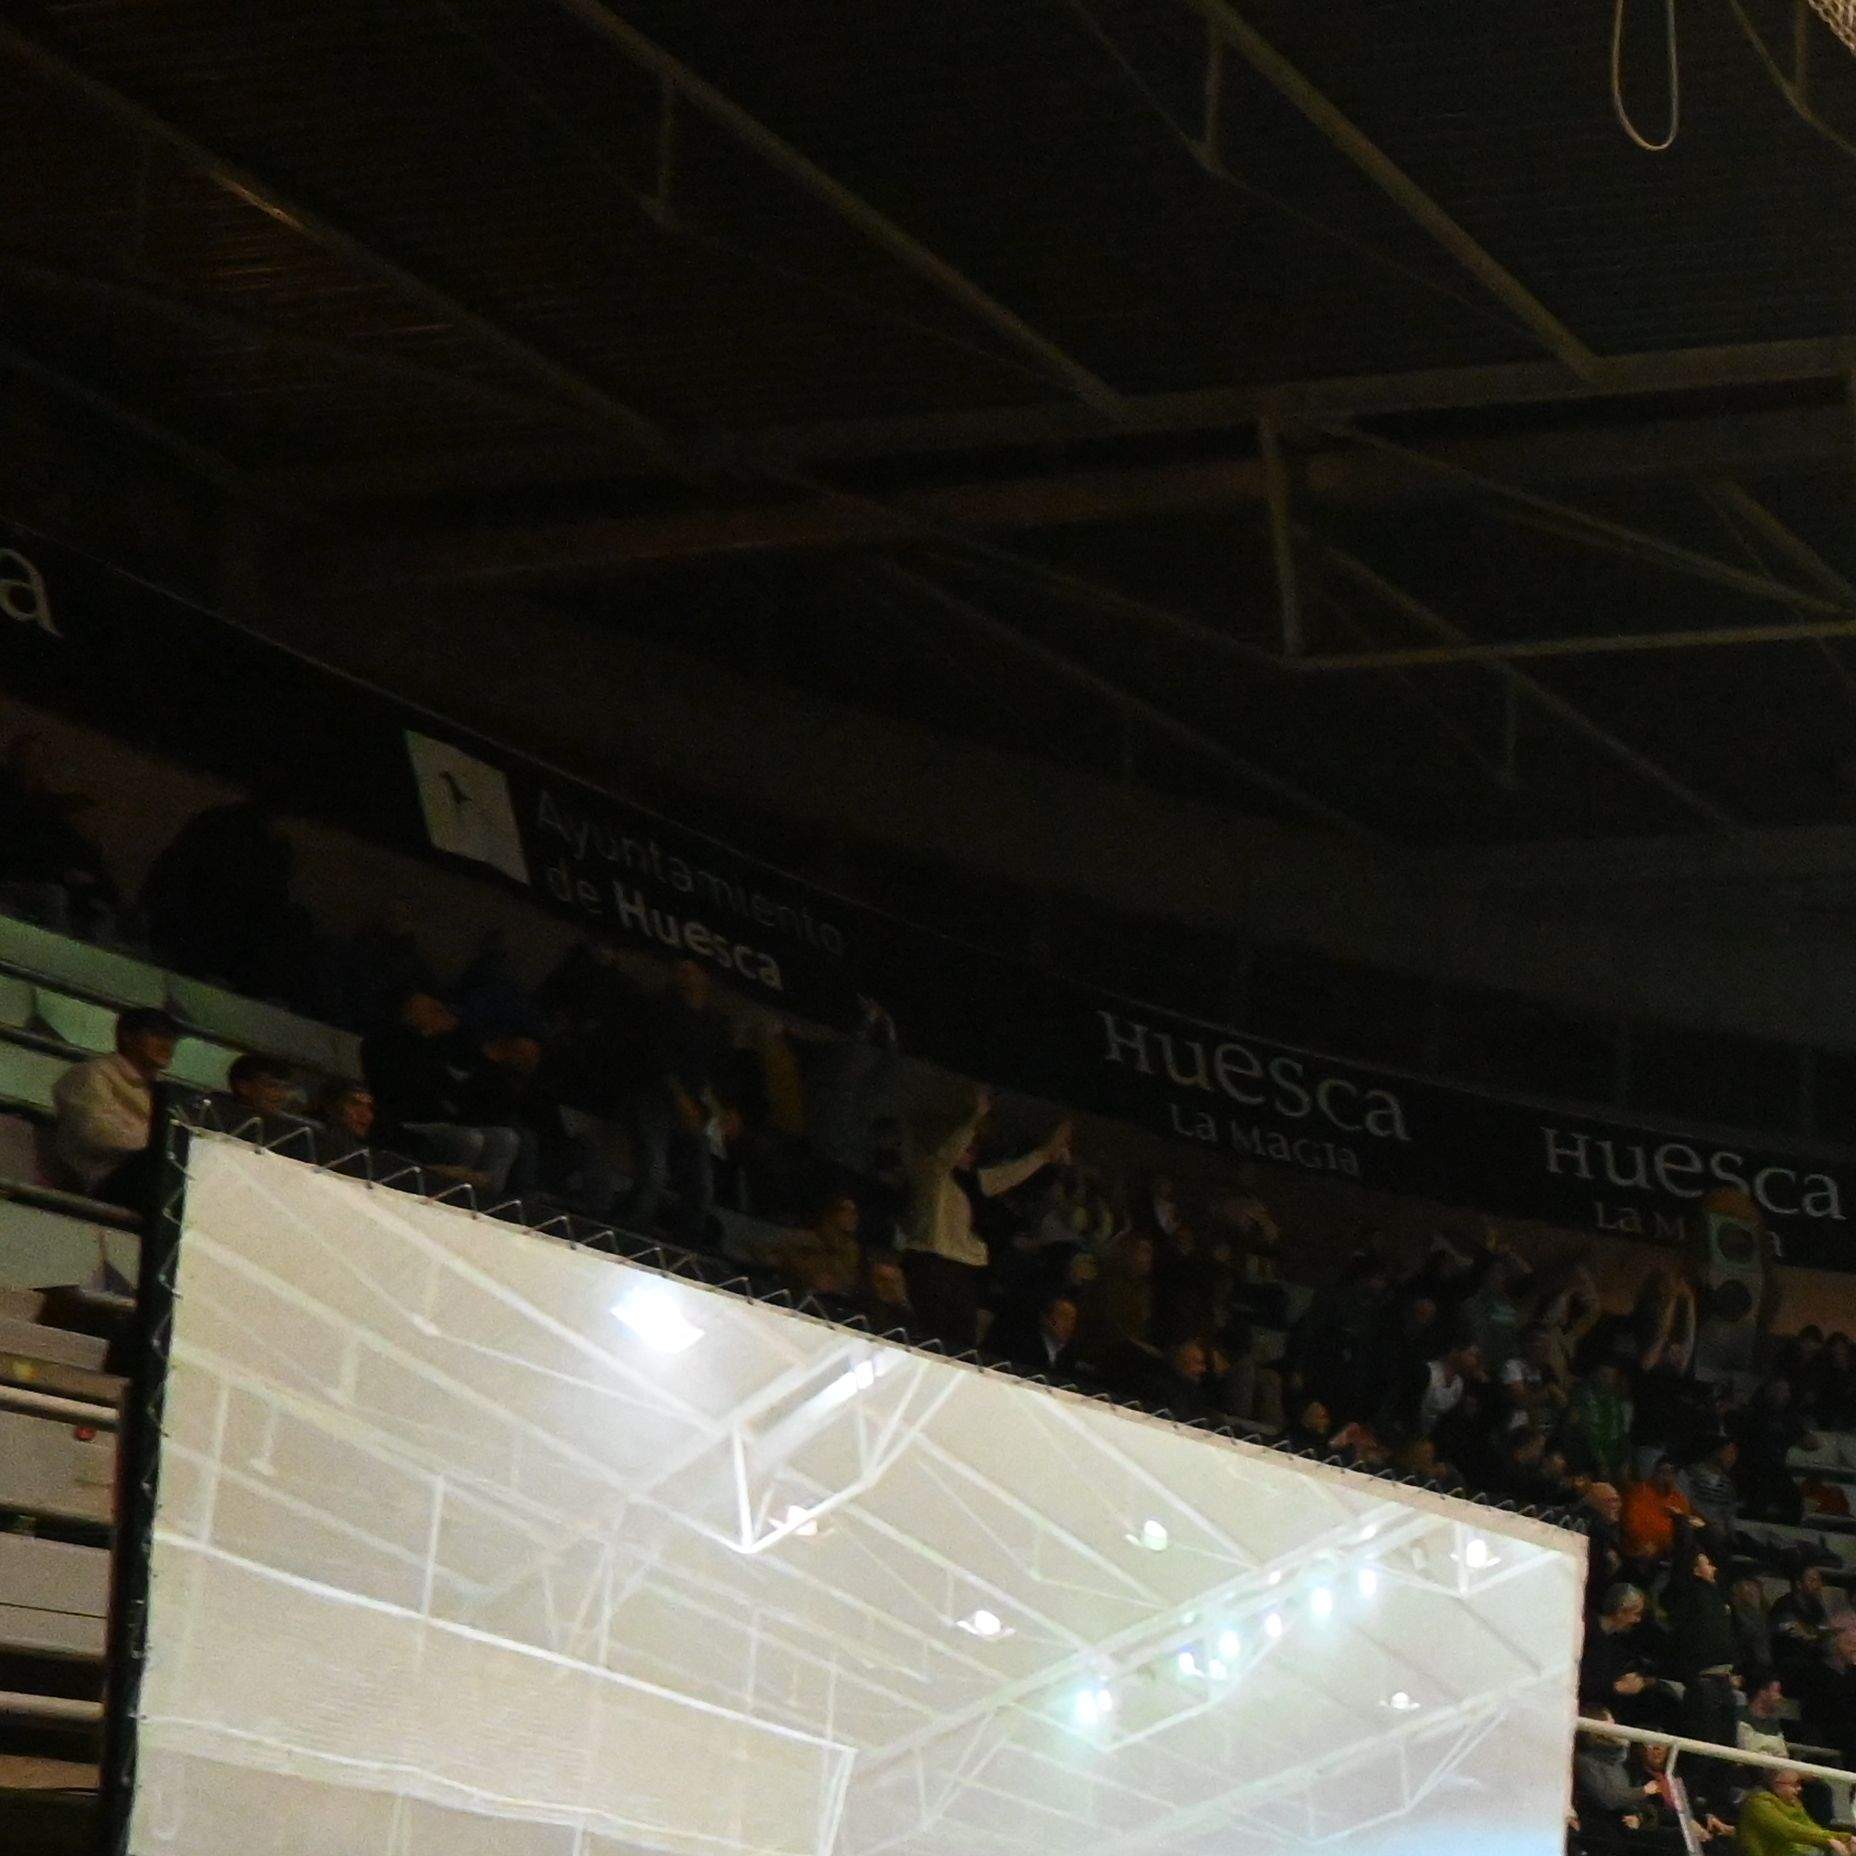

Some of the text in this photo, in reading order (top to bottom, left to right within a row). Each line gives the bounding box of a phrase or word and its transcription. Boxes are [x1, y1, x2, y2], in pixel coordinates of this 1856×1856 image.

[537, 791, 844, 958] Ayuntamiento
[545, 859, 783, 991] de Huesca
